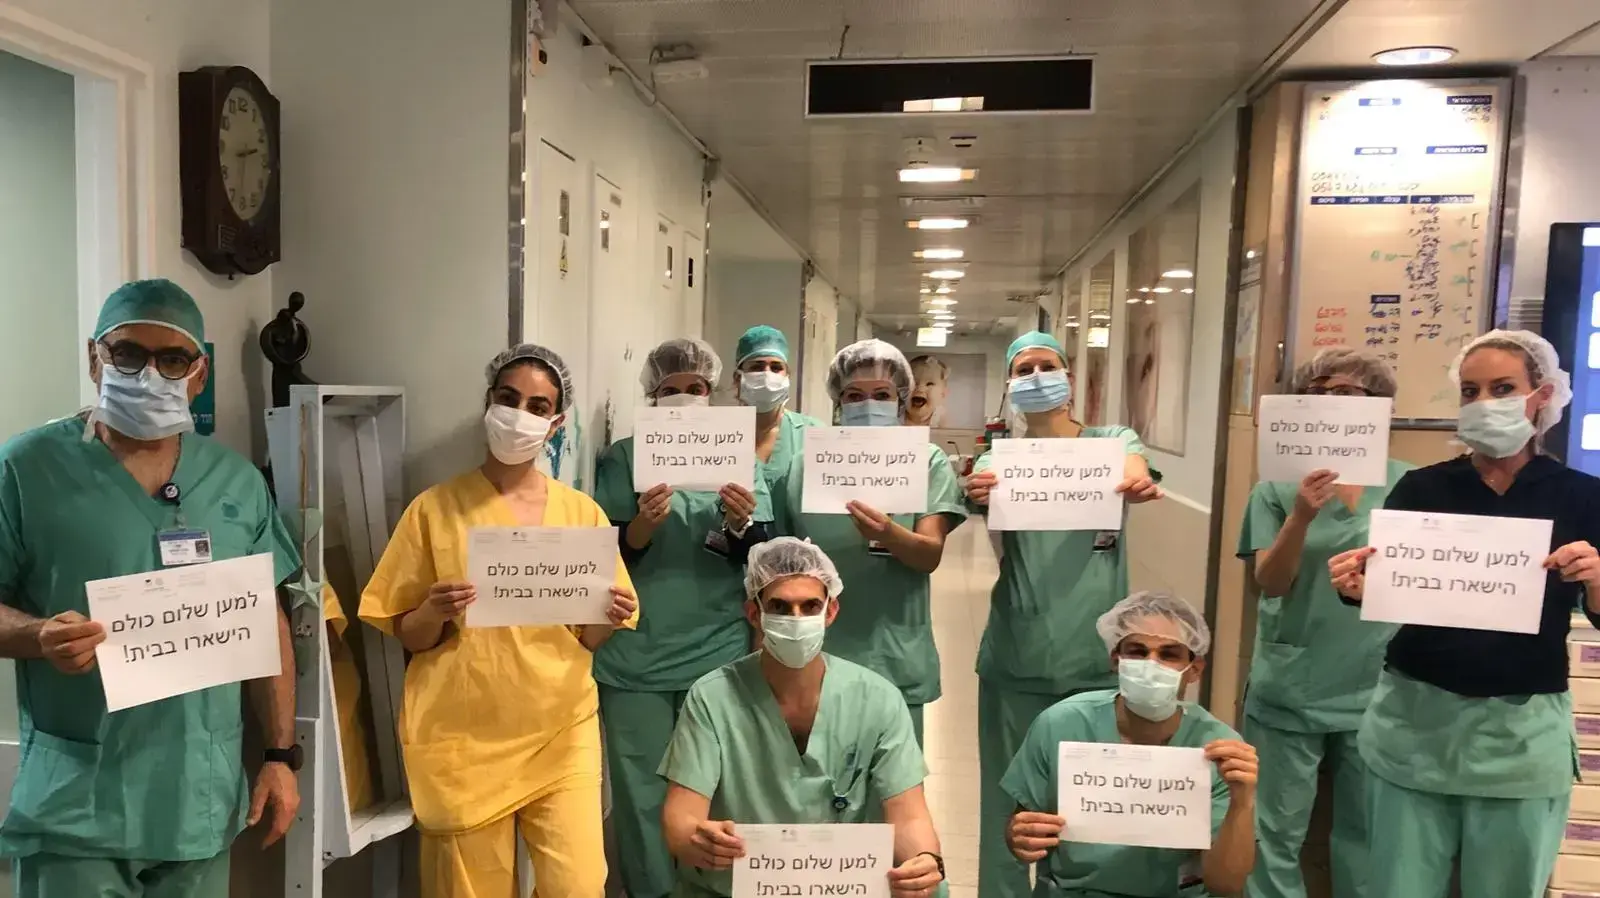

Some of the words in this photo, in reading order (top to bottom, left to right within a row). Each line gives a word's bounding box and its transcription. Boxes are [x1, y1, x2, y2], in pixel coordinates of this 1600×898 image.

[237, 97, 248, 112] 12
[1270, 420, 1299, 432] כולם
[1304, 420, 1339, 433] שלום
[1344, 423, 1376, 436] למען
[646, 432, 673, 444] כולם
[678, 431, 709, 444] שלום
[714, 431, 743, 446] למען
[1276, 442, 1313, 455] בבית!
[1318, 446, 1366, 457] הישארו
[652, 453, 687, 466] בבית!
[692, 456, 736, 465] הישארו
[816, 451, 844, 463] כולם
[848, 451, 880, 464] שלום
[886, 451, 916, 467] למען
[1004, 465, 1034, 478] כולם
[1040, 465, 1074, 478] שלום
[1080, 464, 1111, 480] למען
[822, 473, 857, 486] בבית!
[862, 477, 908, 487] הישארו
[1011, 488, 1048, 502] בבית!
[1054, 491, 1103, 501] הישארו
[1385, 543, 1425, 560] כולם
[1433, 546, 1479, 563] שלום
[1486, 551, 1530, 568] למען
[488, 562, 519, 576] כולם
[525, 562, 559, 576] שלום
[565, 561, 596, 577] למען
[1392, 571, 1442, 590] בבית!
[1449, 579, 1516, 595] הישארו
[494, 586, 534, 599] בבית!
[539, 587, 588, 598] הישארו
[217, 591, 257, 618] למען
[163, 603, 208, 624] שלום
[112, 614, 154, 632] כולם
[185, 627, 250, 650] הישארו
[124, 641, 177, 663] בבית!
[1073, 771, 1107, 787] כולם
[1113, 774, 1151, 789] שלום
[1158, 777, 1195, 793] למען
[1081, 797, 1124, 814] בבית!
[1130, 803, 1186, 816] הישארו
[750, 854, 785, 870] כולם
[793, 854, 832, 870] שלום
[840, 854, 876, 872] למען
[757, 881, 802, 896] בבית!
[809, 884, 866, 895] הישארו
